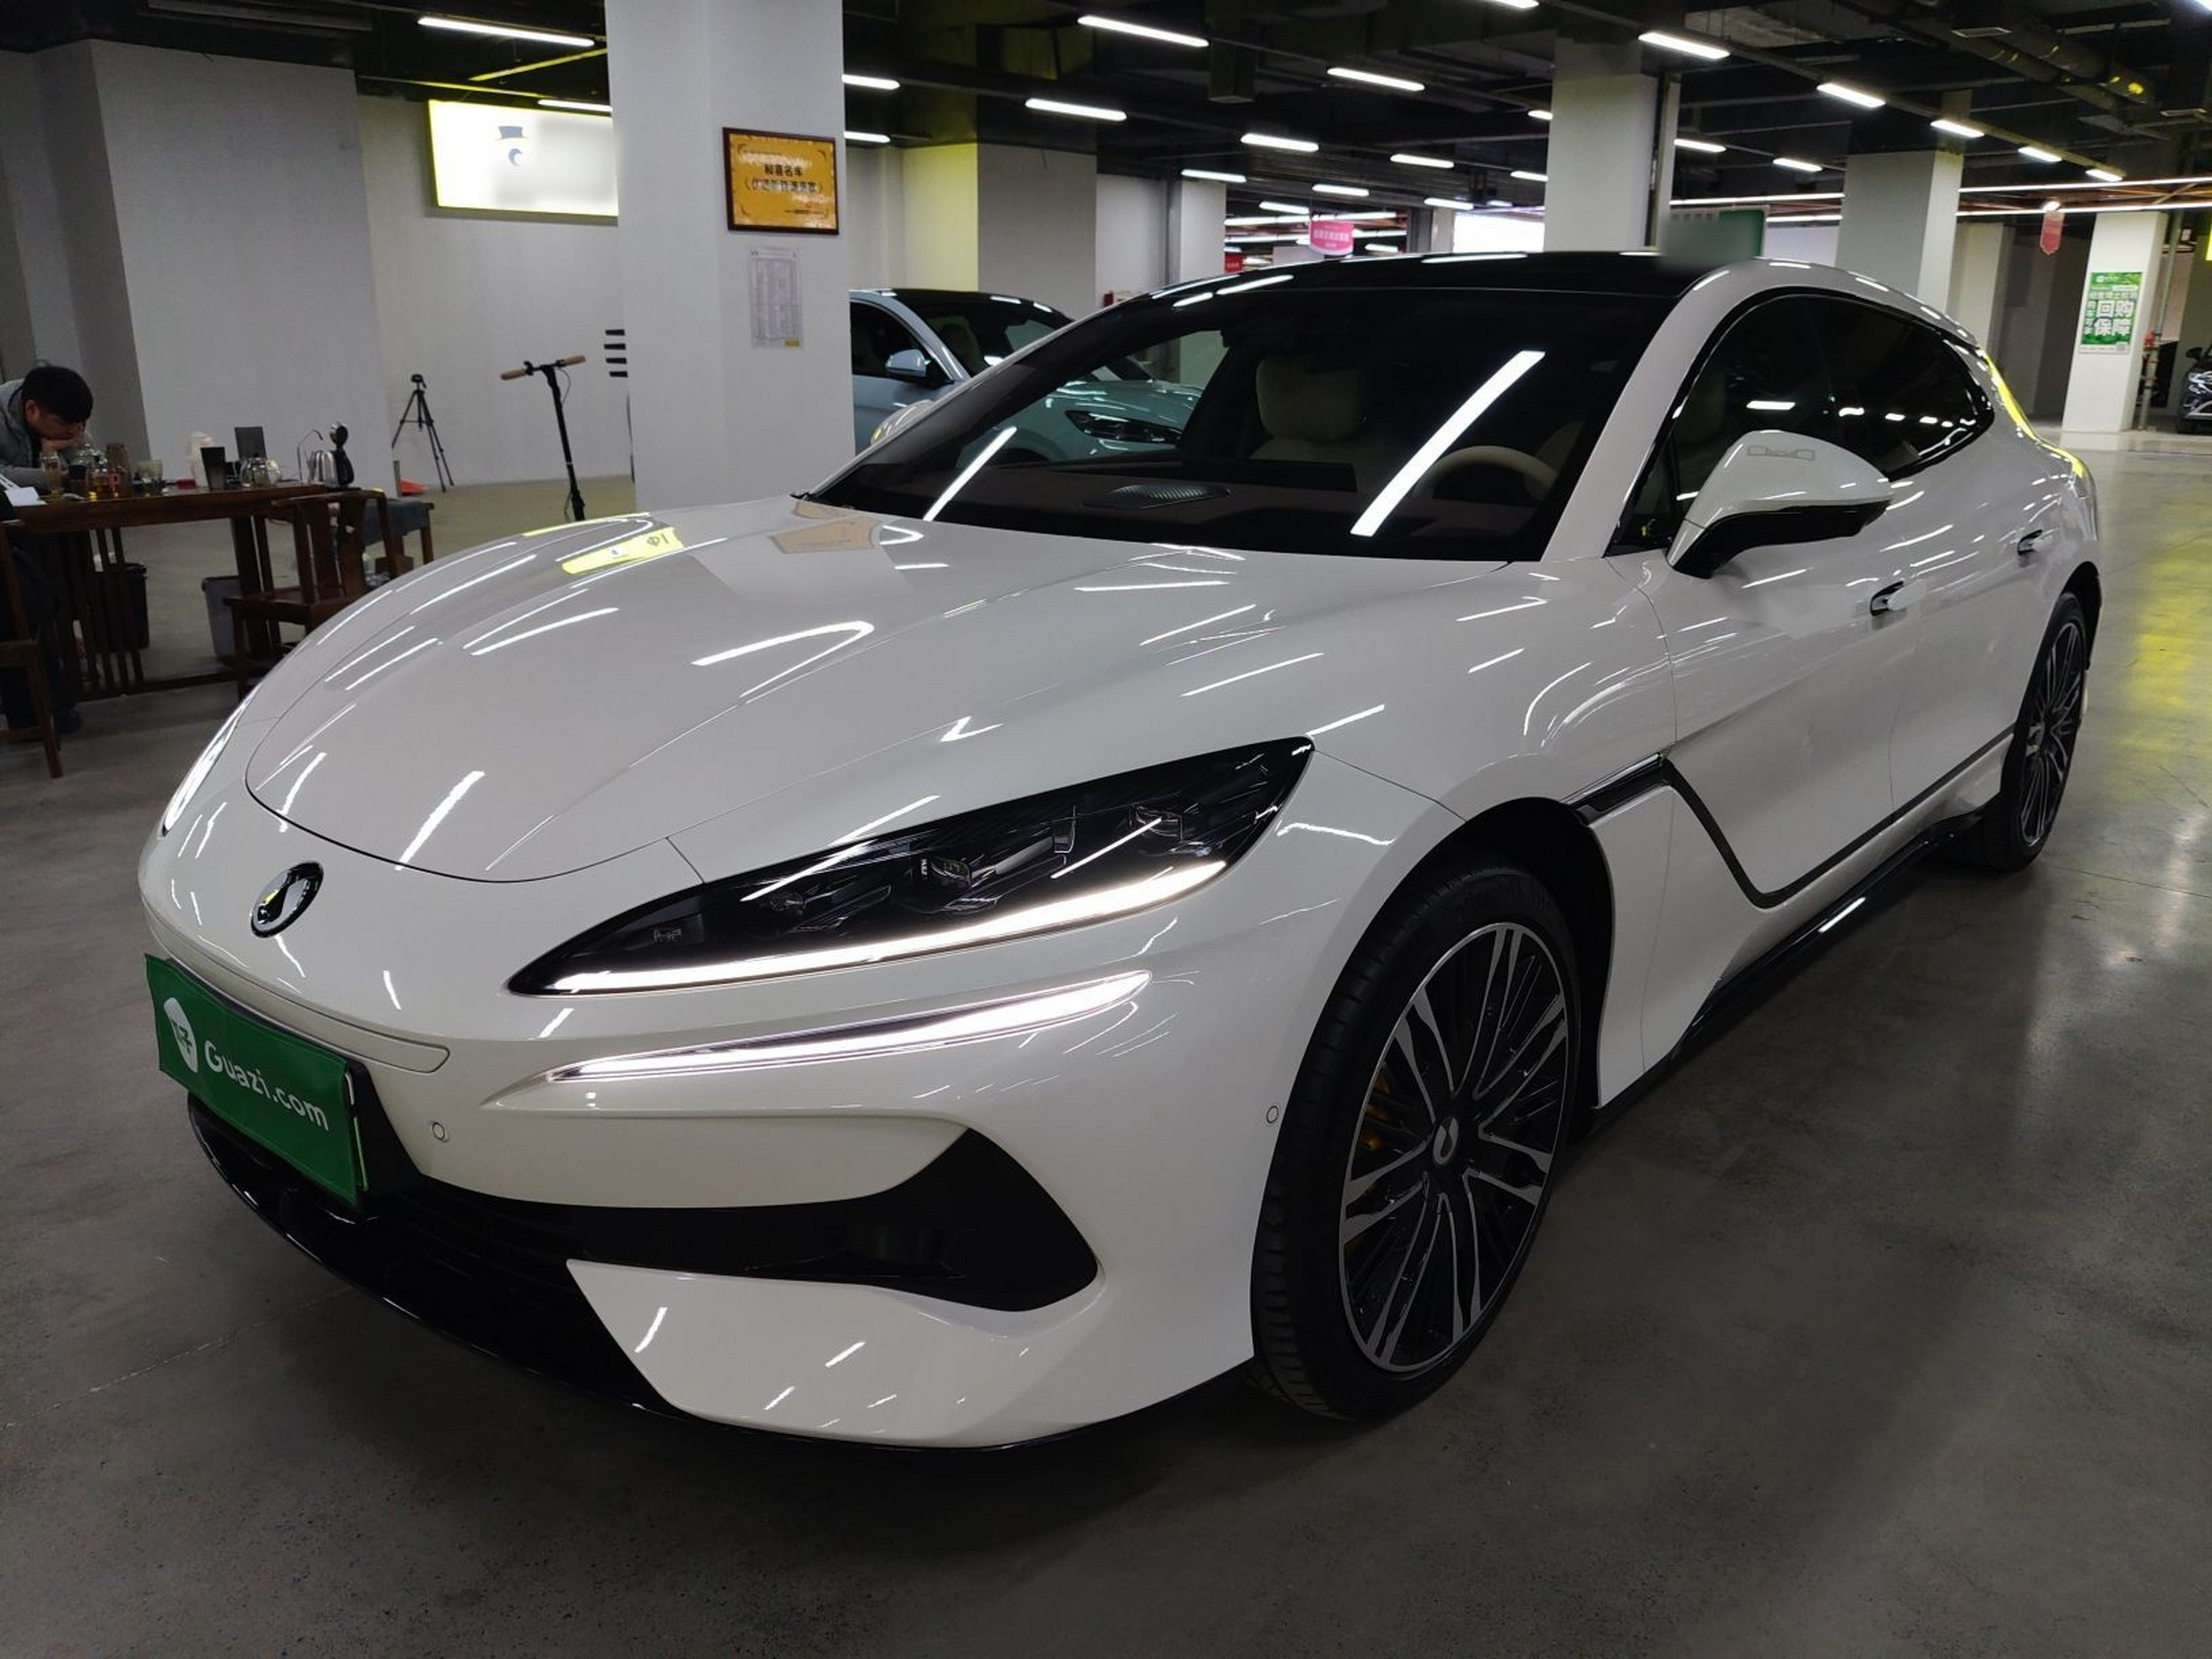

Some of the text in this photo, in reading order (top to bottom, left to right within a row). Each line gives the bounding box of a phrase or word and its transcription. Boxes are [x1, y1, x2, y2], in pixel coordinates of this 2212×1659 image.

[2096, 300, 2135, 318] 回购
[2093, 317, 2132, 336] 保障
[204, 1040, 329, 1131] Guazi.com
